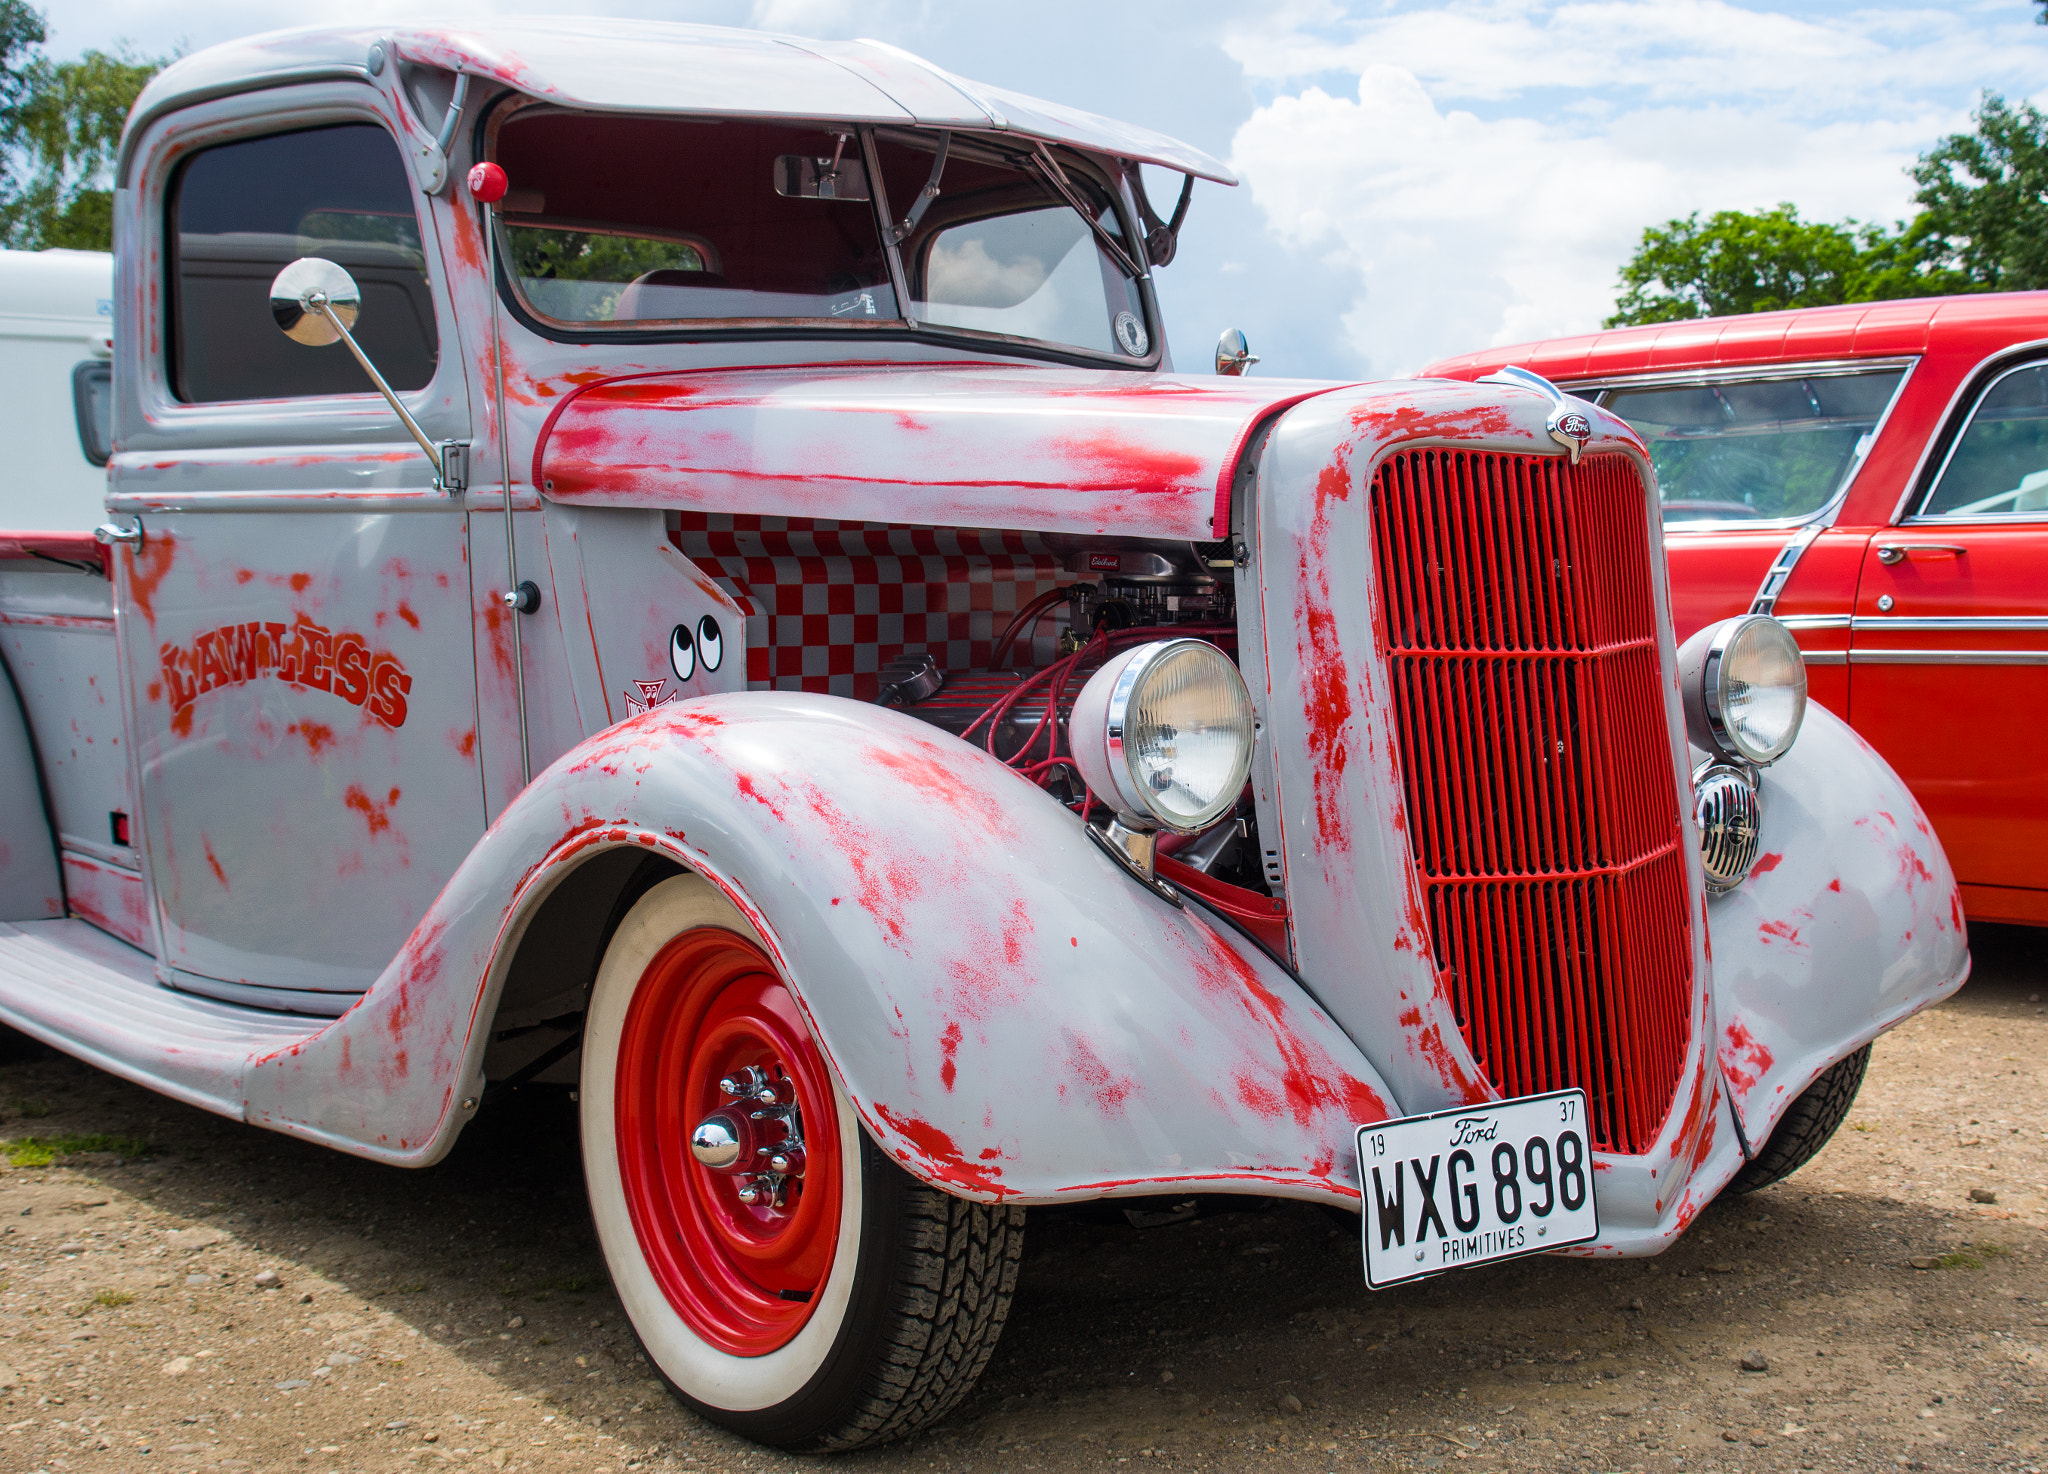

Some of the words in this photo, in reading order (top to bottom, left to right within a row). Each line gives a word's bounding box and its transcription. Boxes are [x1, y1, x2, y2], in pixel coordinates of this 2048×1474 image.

[1565, 415, 1589, 432] Ford
[161, 621, 412, 728] LAWLESS
[1370, 1133, 1385, 1156] 19
[1449, 1116, 1499, 1147] Ford
[1559, 1100, 1575, 1122] 37
[1371, 1148, 1480, 1251] WXG
[1491, 1130, 1586, 1224] 898
[1442, 1226, 1525, 1262] PRIMITIVES
